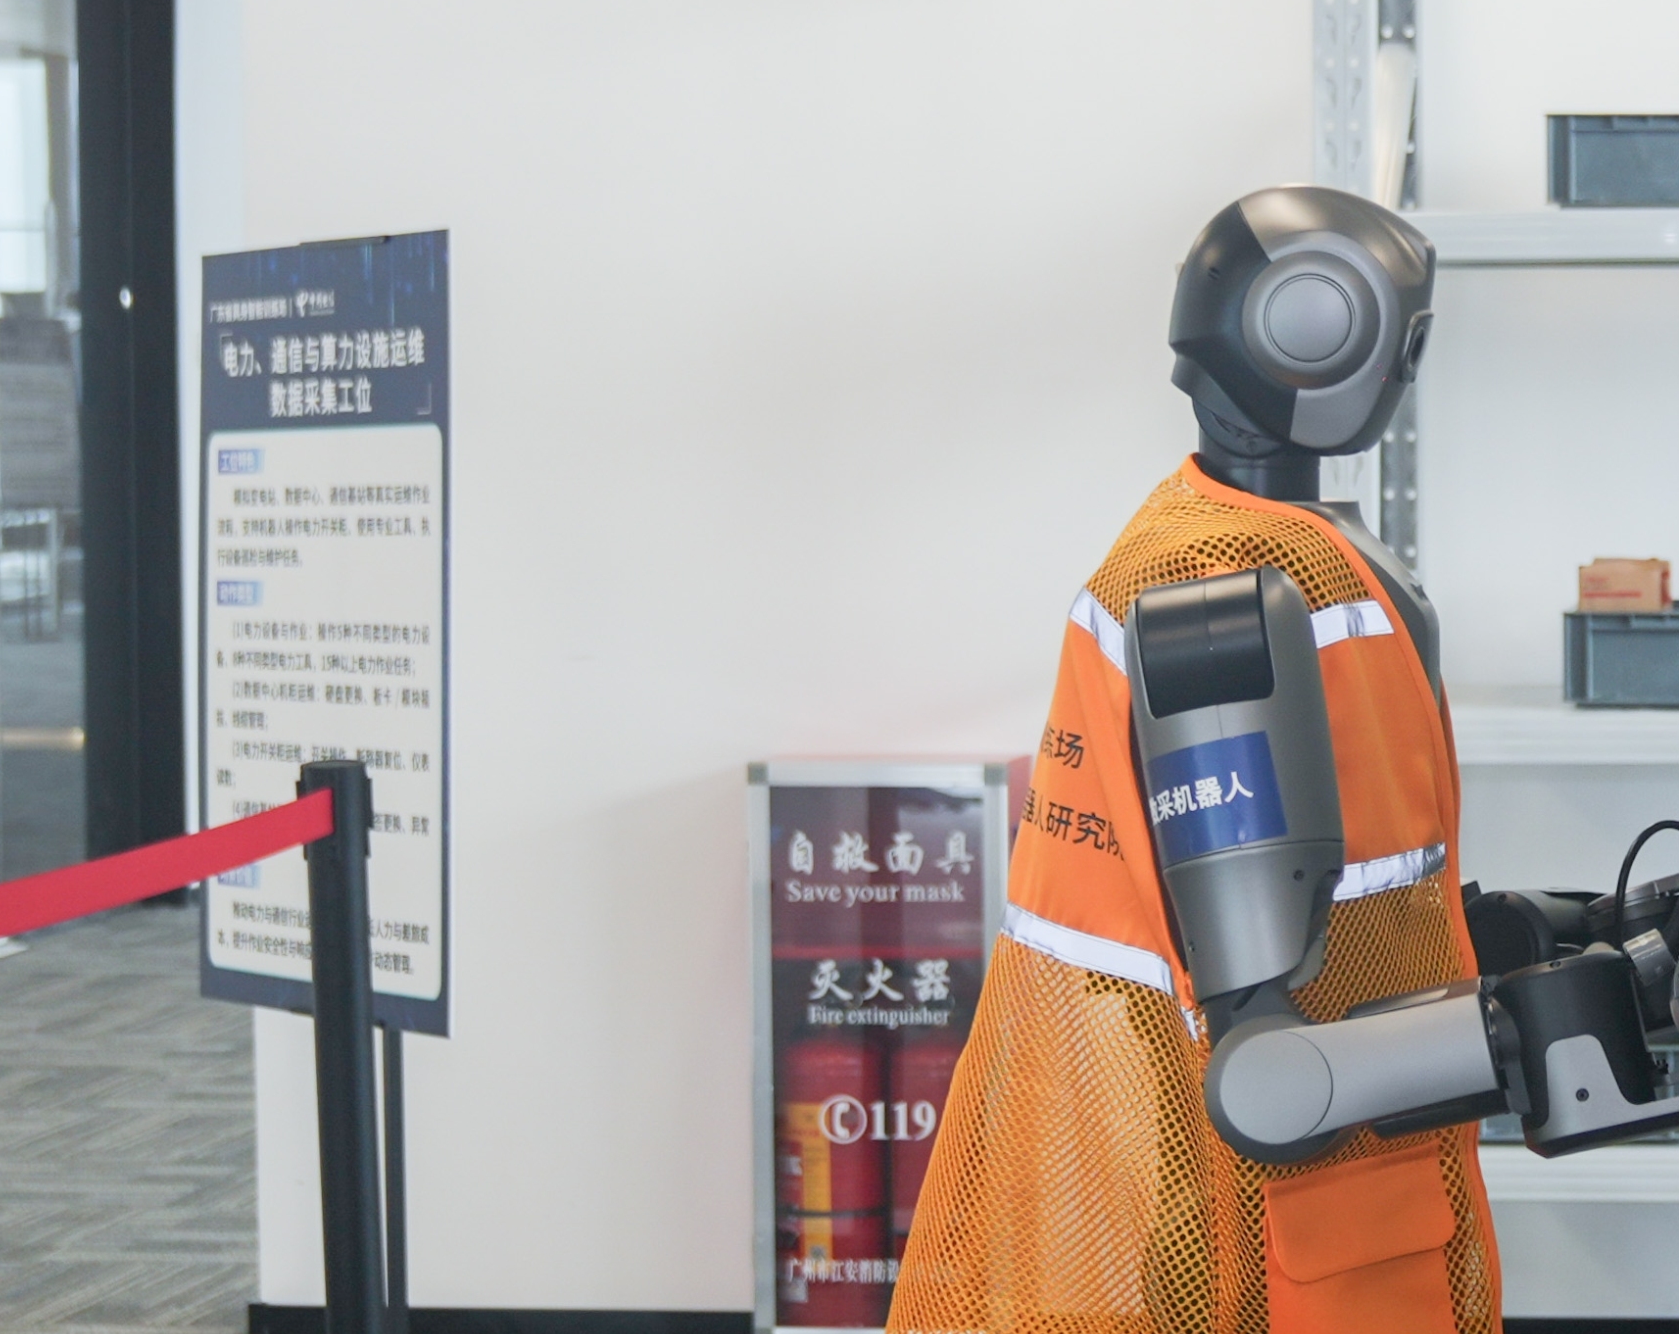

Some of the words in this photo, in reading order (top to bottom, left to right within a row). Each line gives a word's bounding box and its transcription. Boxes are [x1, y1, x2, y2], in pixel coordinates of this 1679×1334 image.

[224, 326, 425, 378] 电力、通信与算力设施运维
[269, 375, 372, 418] 数据采集工位
[788, 830, 974, 875] 自救面具
[786, 879, 841, 902] Save
[845, 884, 900, 908] your
[904, 879, 966, 902] mask
[809, 958, 951, 1002] 灭火器
[807, 1005, 844, 1025] Fire
[847, 1004, 950, 1031] extinguisher
[870, 1100, 937, 1142] 119
